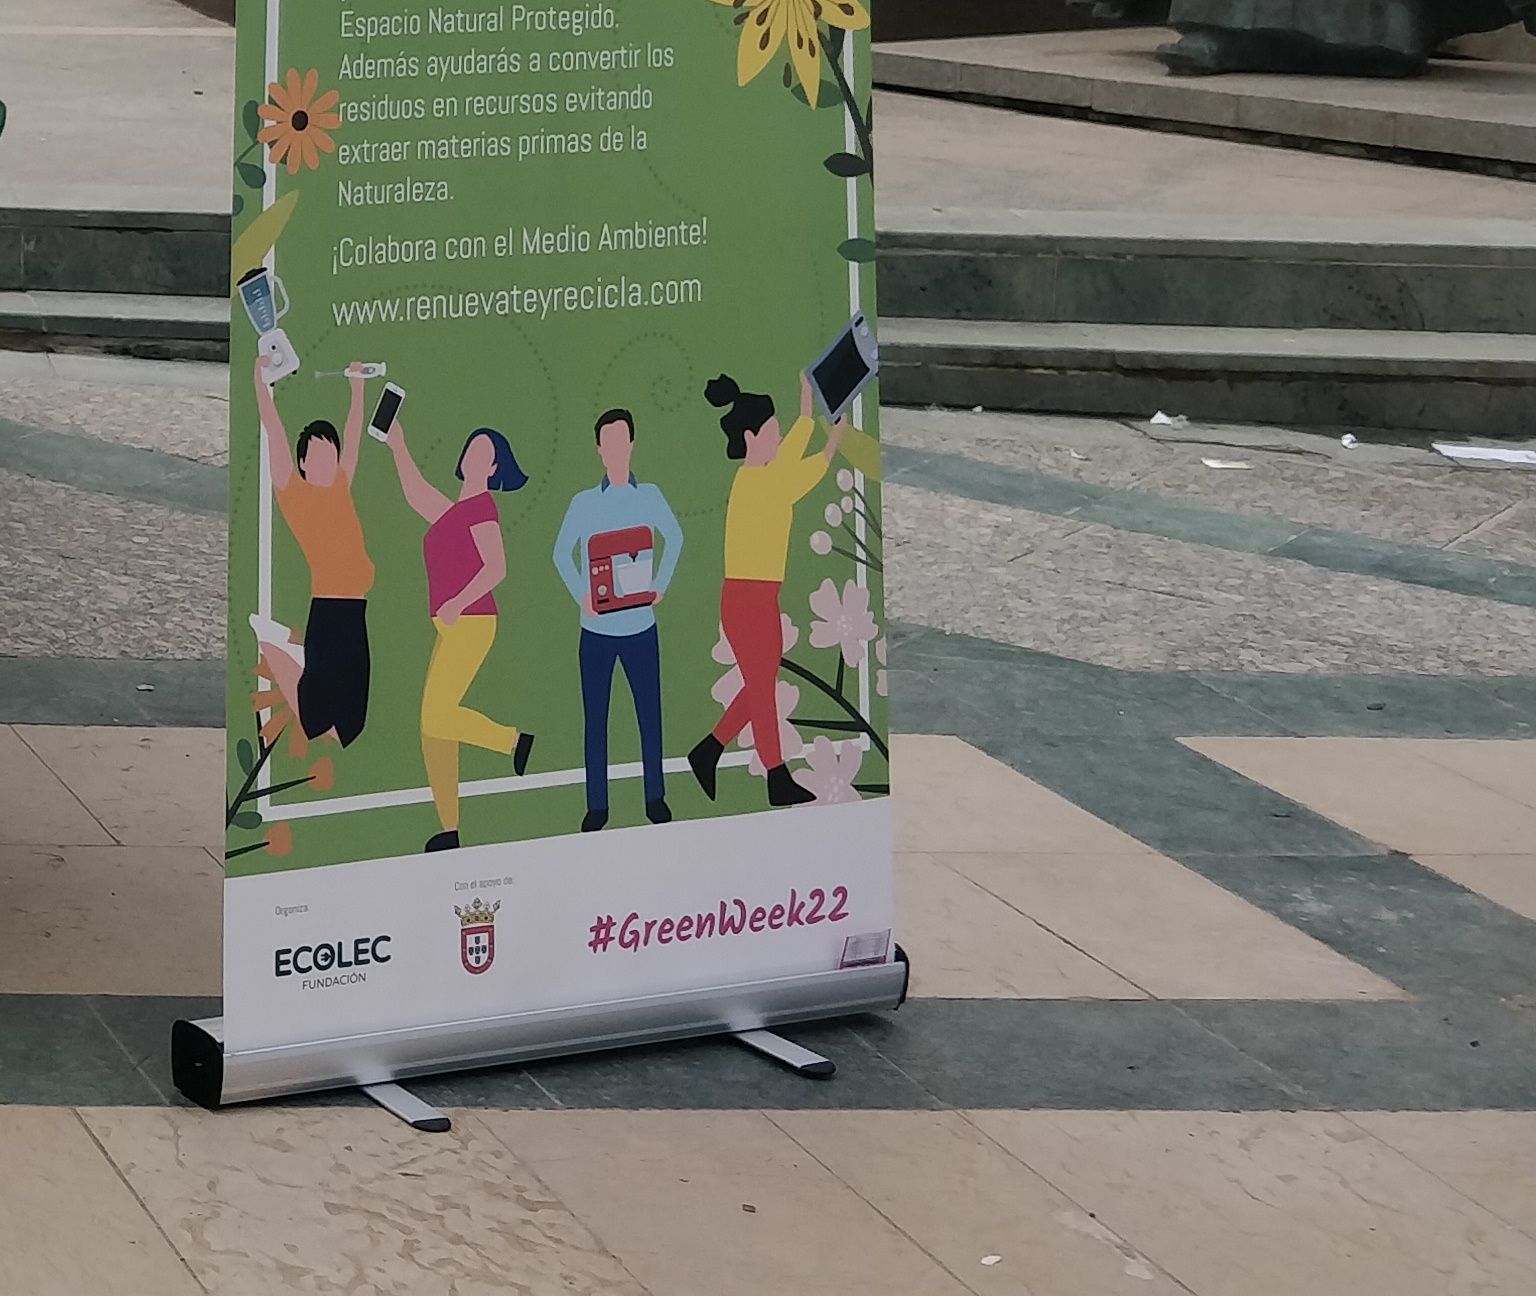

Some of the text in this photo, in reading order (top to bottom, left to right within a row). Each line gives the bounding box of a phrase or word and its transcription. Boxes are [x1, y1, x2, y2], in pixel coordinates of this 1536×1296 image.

[340, 4, 620, 42] Espacio Natural Protegido.
[339, 41, 674, 80] Además ayudarás a convertir los
[339, 86, 653, 122] residuos en recursos evitando
[338, 126, 648, 166] extraer materias primas de la
[338, 178, 455, 208] Naturaleza.
[331, 217, 708, 274] ¡Colabora con el Medio Ambiente!
[331, 276, 702, 326] www.renuevateyrecicla.com
[587, 885, 850, 955] #GreenWeek22
[274, 935, 392, 977] ECOLEC
[301, 972, 368, 991] FUNDACIÓN
